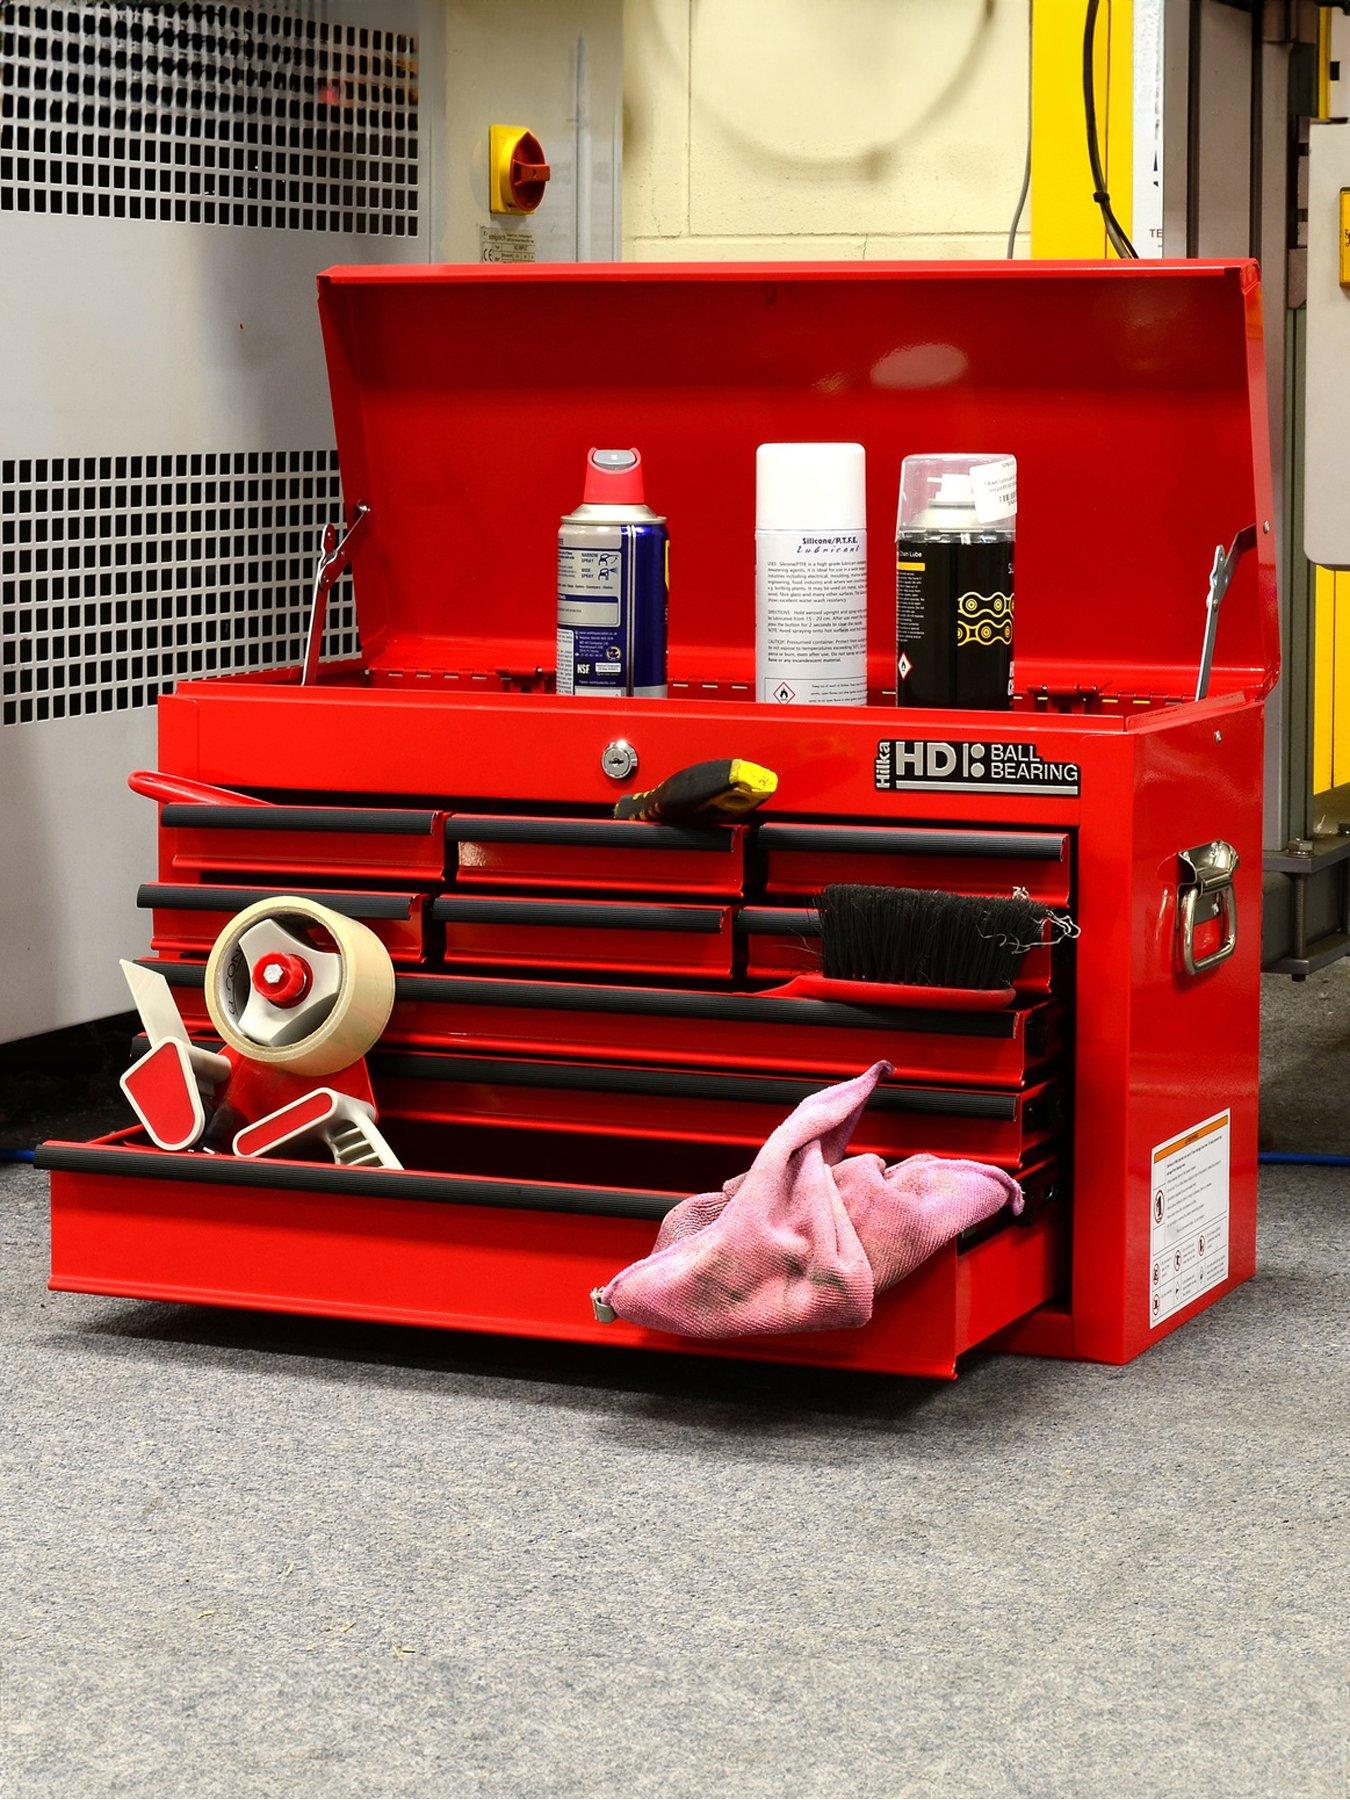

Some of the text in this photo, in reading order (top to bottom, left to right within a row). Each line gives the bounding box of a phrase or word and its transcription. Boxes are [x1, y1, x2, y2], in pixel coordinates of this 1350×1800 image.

[577, 664, 590, 674] NSF
[991, 745, 1041, 764] BALL
[876, 742, 891, 789] Hilka
[991, 763, 1079, 782] BEARING
